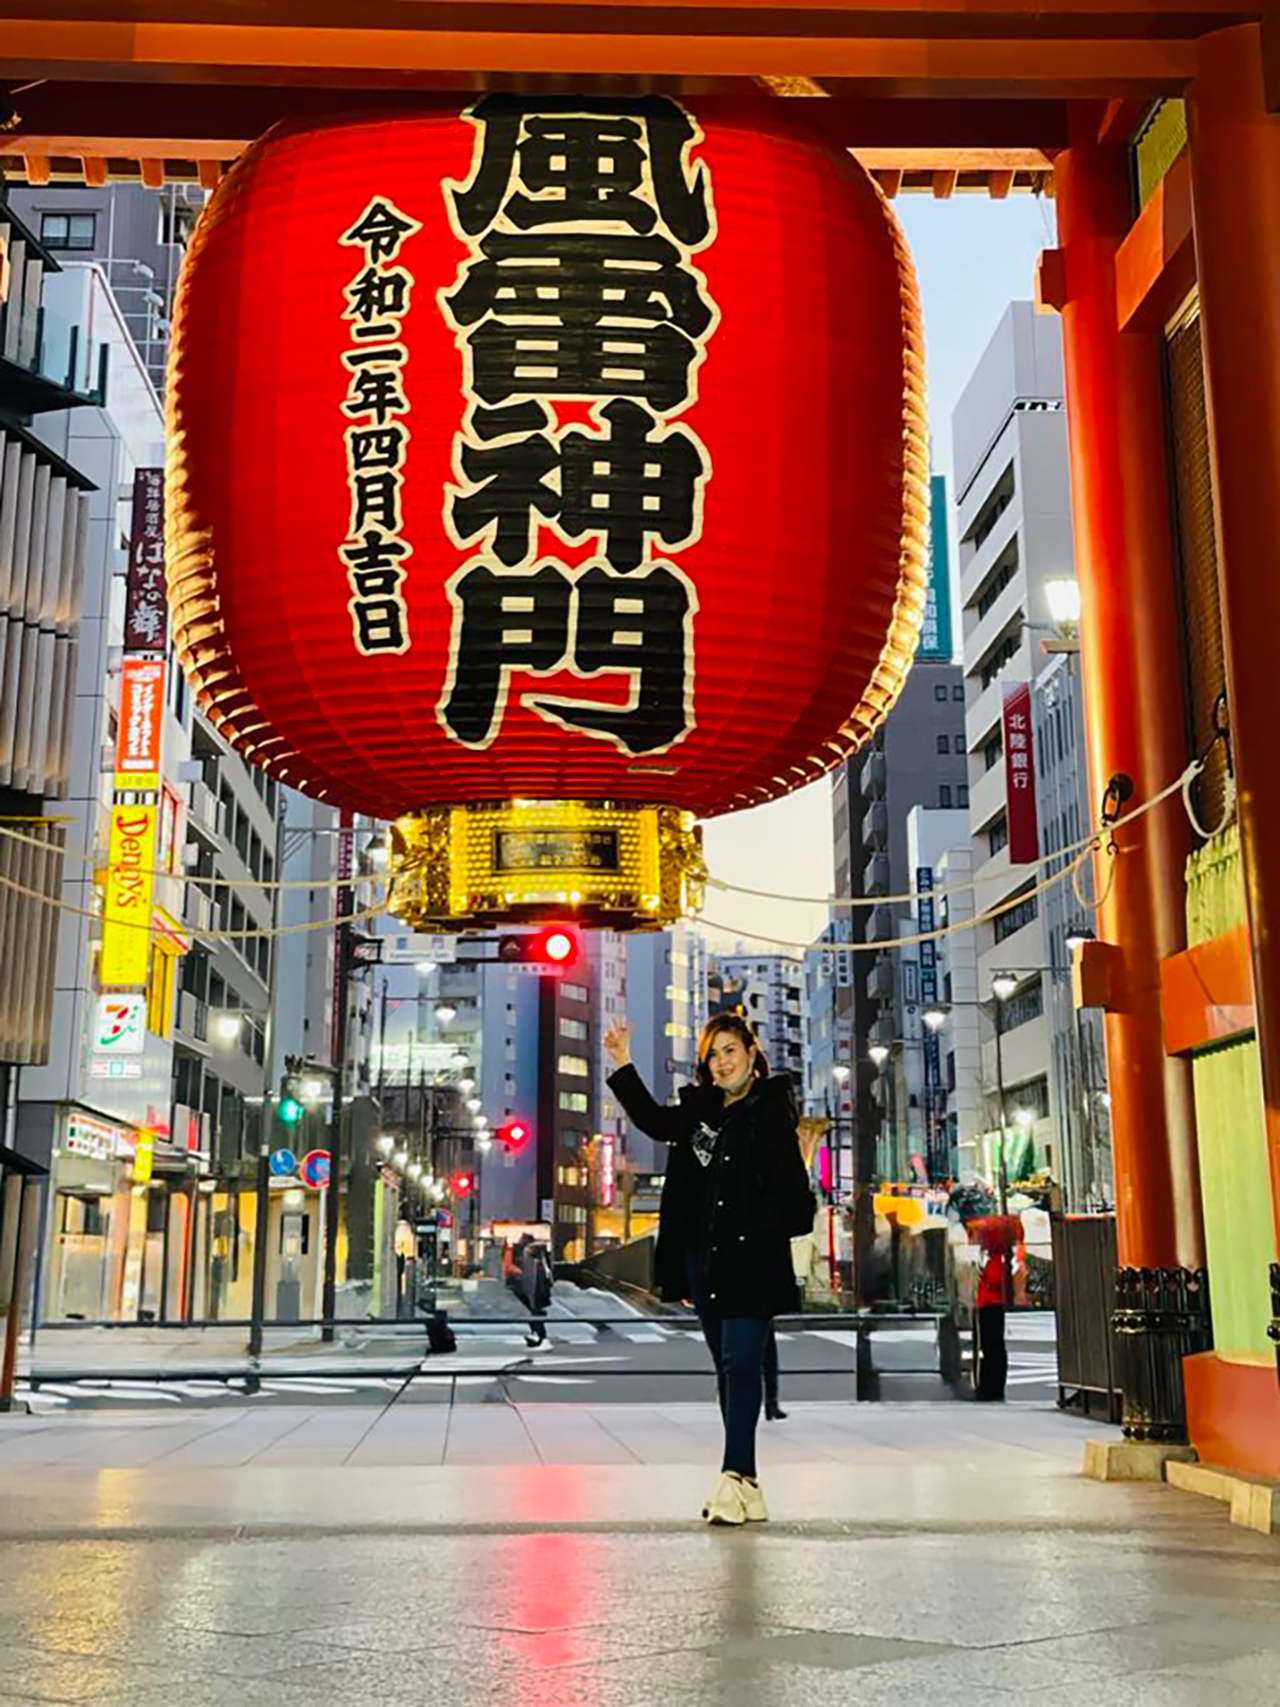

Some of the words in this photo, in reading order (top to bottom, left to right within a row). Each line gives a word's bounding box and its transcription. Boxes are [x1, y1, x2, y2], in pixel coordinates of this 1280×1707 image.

[338, 196, 422, 656] 令和二年四月吉日
[439, 93, 731, 757] 風雷神門
[114, 814, 148, 908] Denny's
[1009, 714, 1028, 789] 北陸銀行
